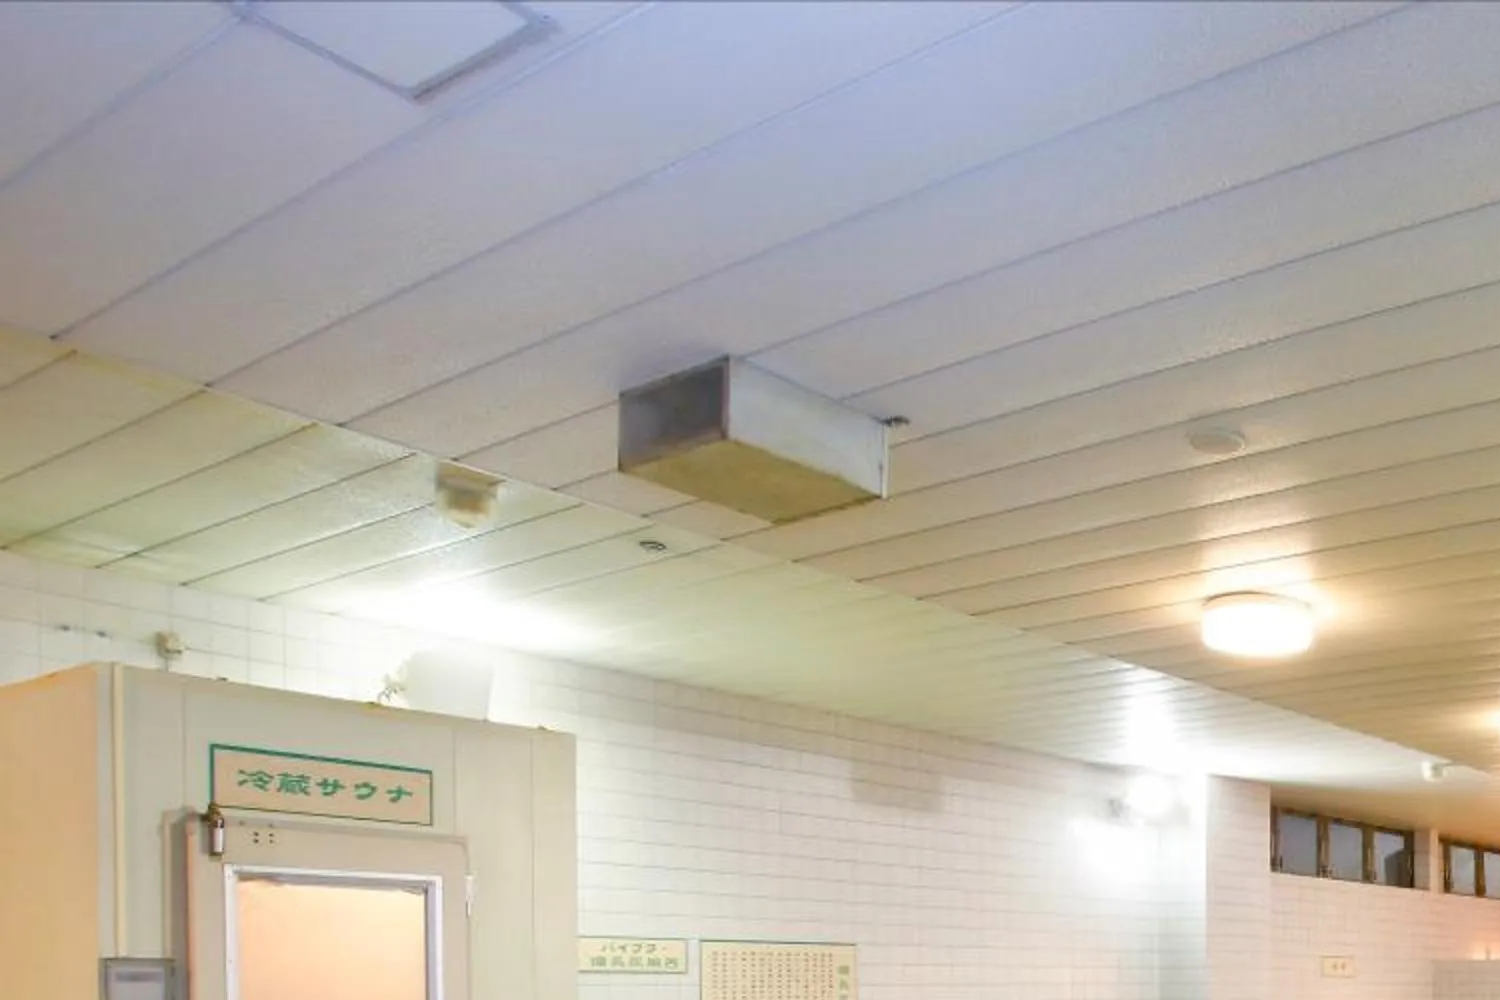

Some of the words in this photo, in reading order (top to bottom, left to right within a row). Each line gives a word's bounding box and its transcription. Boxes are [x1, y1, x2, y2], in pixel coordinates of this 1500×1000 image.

[237, 769, 414, 804] 冷蔵サウナ
